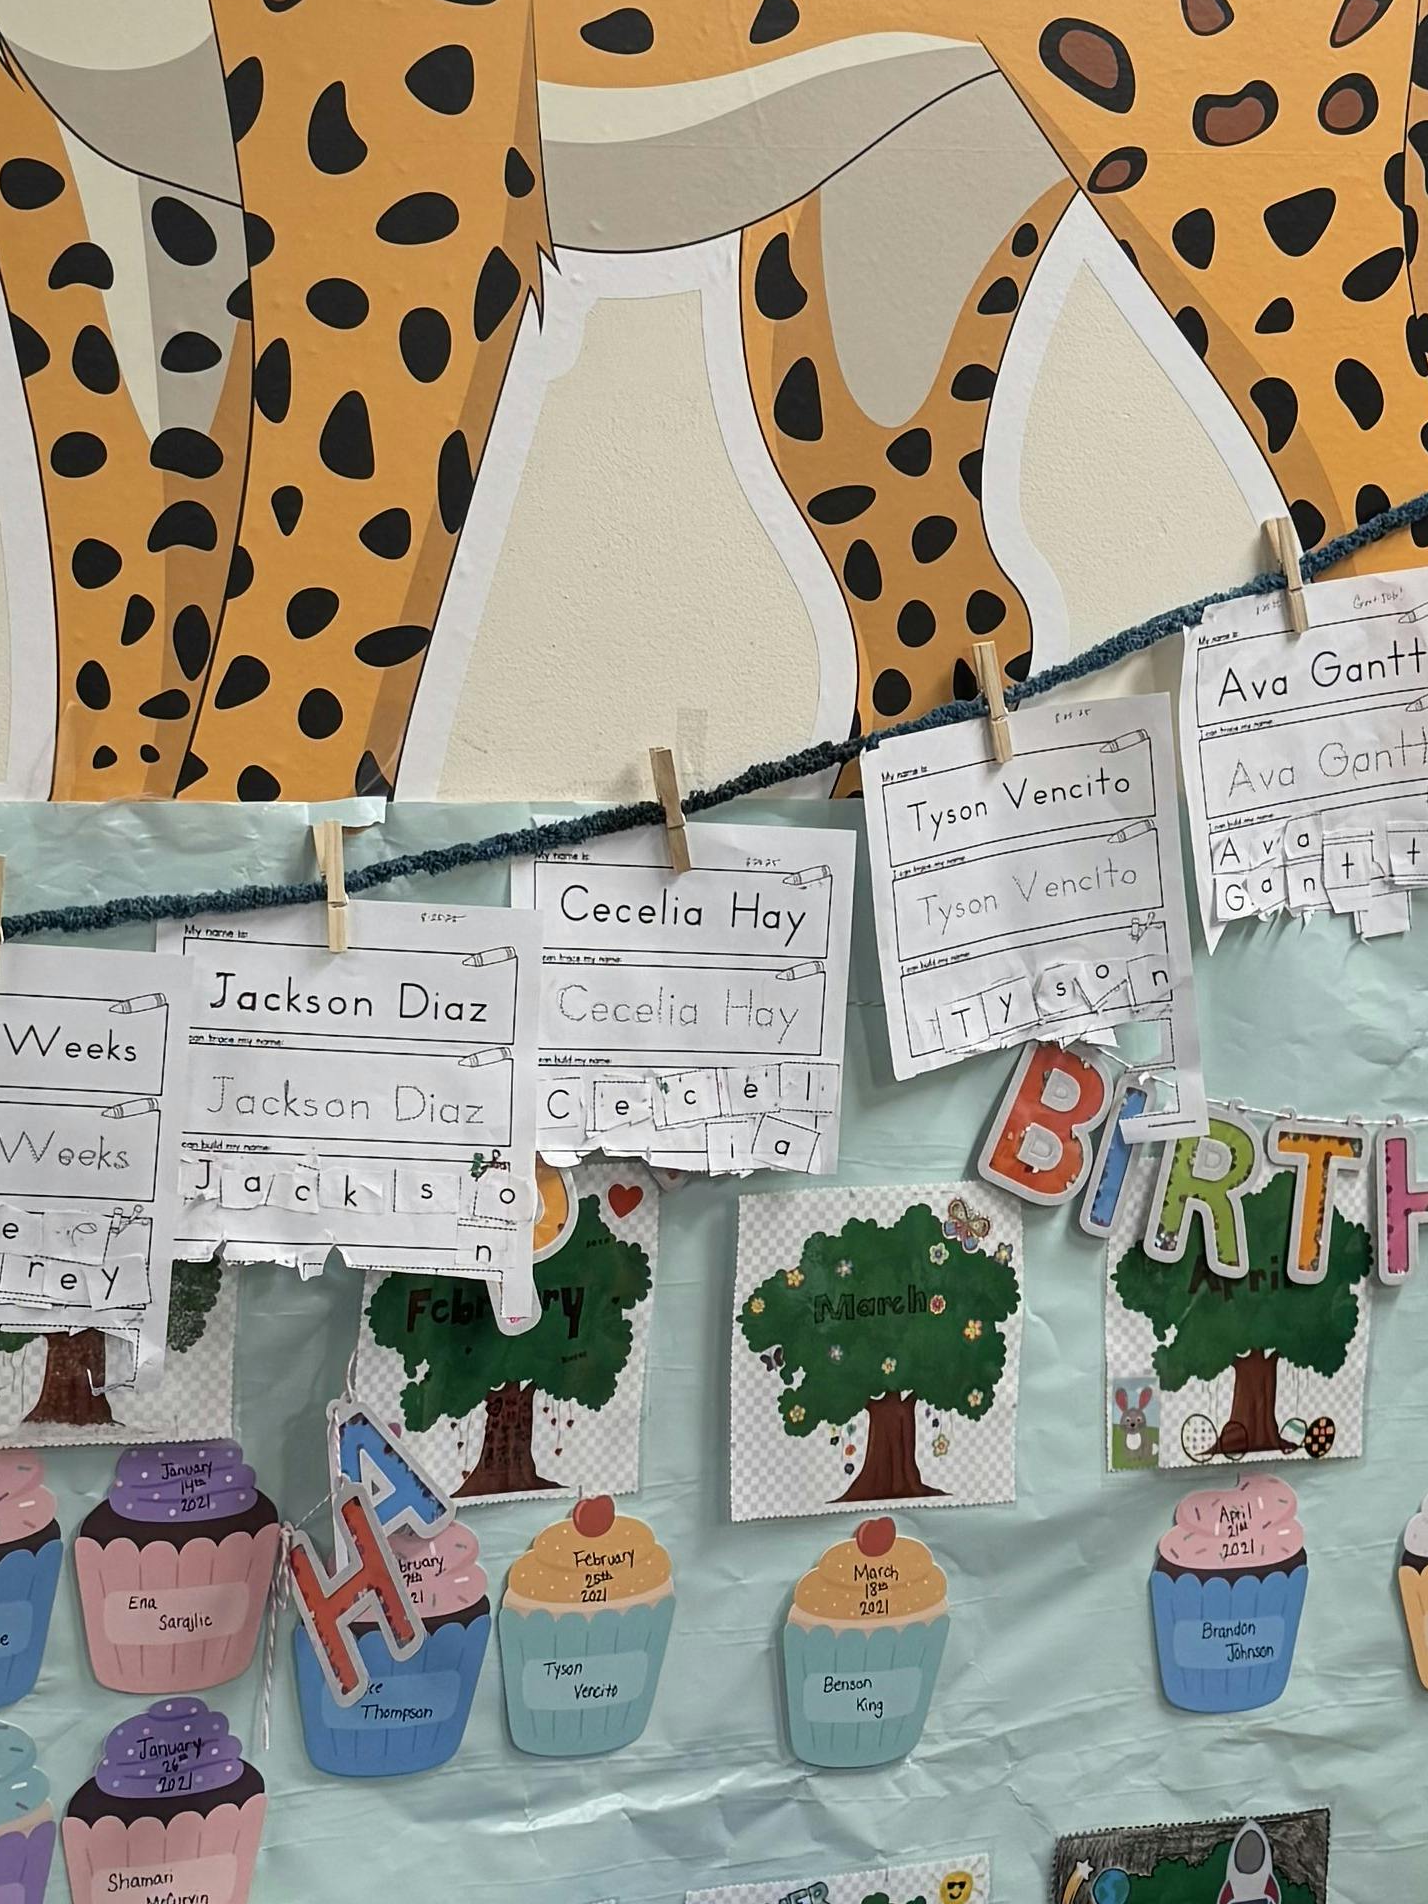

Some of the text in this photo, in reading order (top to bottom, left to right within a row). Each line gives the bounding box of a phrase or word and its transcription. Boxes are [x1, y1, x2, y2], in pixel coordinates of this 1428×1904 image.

[1218, 637, 1427, 707] Ava Gantt
[1229, 759, 1295, 798] Ava
[907, 767, 1130, 841] Tyson Vencito
[917, 894, 998, 936] Tyson
[1012, 858, 1137, 902] Vencito
[560, 884, 806, 947] Cecelia Hay
[210, 972, 487, 1023] Jackson Diaz
[558, 984, 799, 1044] Cecelia Hay
[3, 1023, 137, 1062] Weeks
[207, 1076, 484, 1125] Jackson Diaz
[813, 1283, 929, 1324] March
[161, 1460, 212, 1481] January
[180, 1494, 210, 1512] 2021
[1219, 1501, 1252, 1525] April
[573, 1548, 635, 1571] February
[1223, 1539, 1255, 1559] 2021
[398, 1553, 445, 1576] bruary
[854, 1564, 899, 1581] March
[585, 1572, 613, 1589] 25th
[865, 1582, 888, 1599] 18th
[128, 1596, 158, 1611] Ena
[580, 1587, 608, 1604] 2021
[860, 1599, 889, 1616] 2021
[1202, 1621, 1256, 1640] Brandon
[1225, 1642, 1274, 1662] Johnson
[543, 1660, 582, 1679] Tyson
[573, 1682, 618, 1700] Vencito
[823, 1676, 872, 1694] Benson
[361, 1704, 433, 1723] Thompson
[856, 1697, 883, 1718] King
[137, 1736, 202, 1761] January
[158, 1775, 193, 1794] 2021
